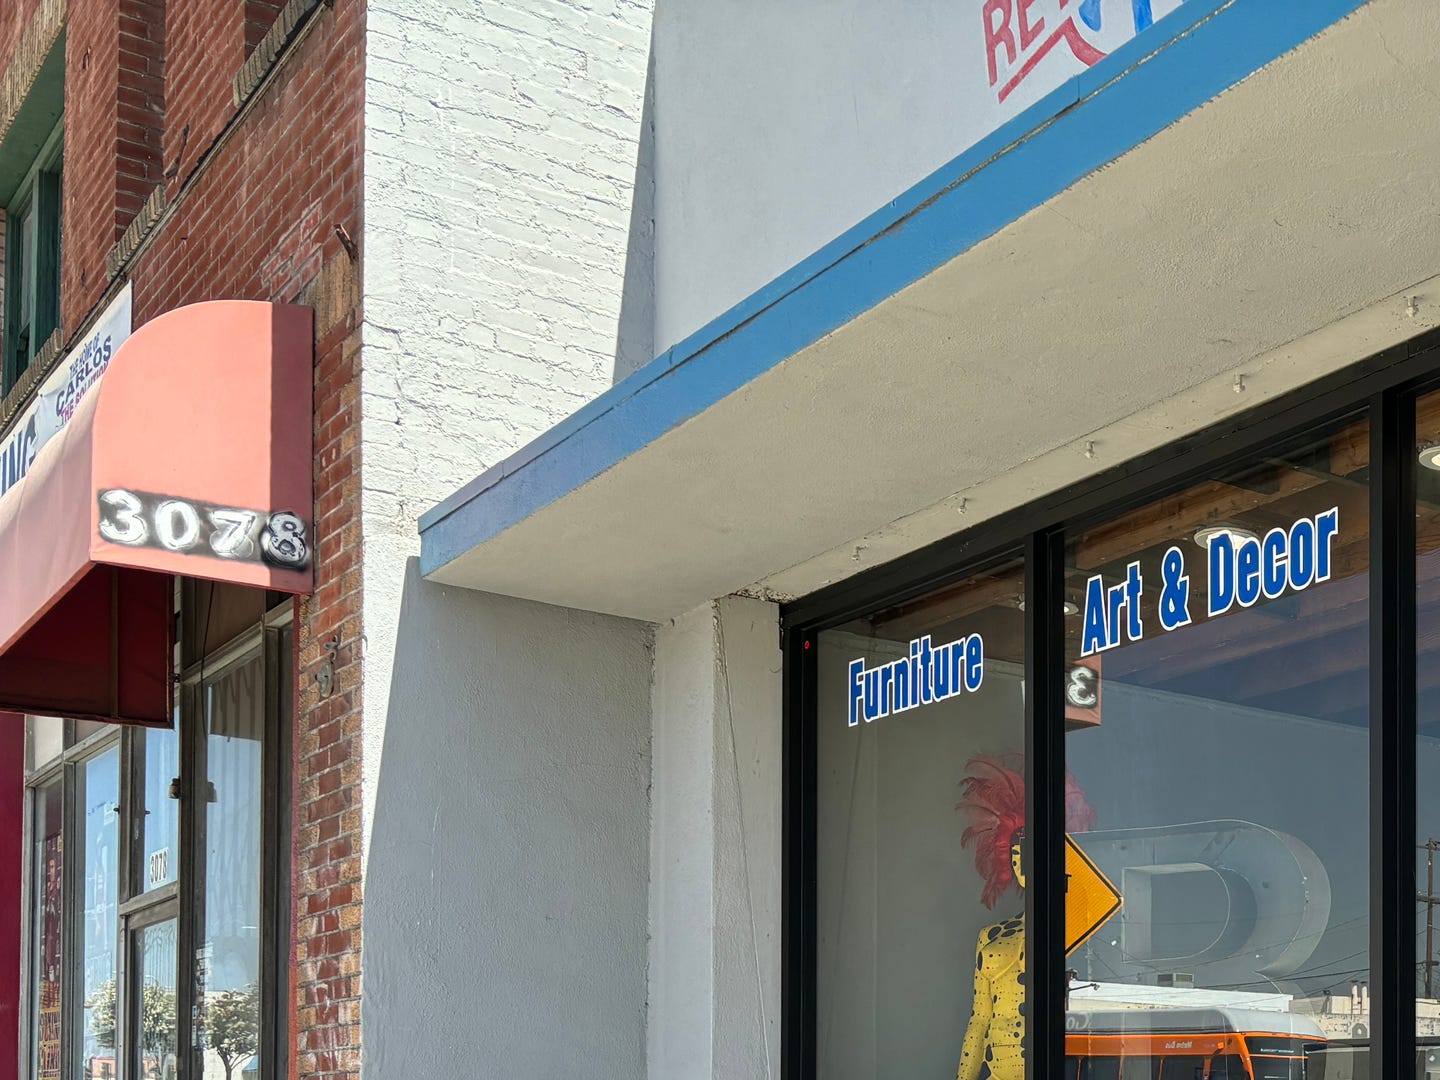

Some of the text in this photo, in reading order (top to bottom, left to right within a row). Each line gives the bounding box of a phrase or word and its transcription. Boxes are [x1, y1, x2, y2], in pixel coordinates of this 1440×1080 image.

[56, 335, 111, 417] CARLOS
[98, 489, 307, 567] 3078
[1080, 506, 1339, 658] Art & Decor
[848, 632, 984, 727] Furniture
[150, 851, 167, 883] 3078
